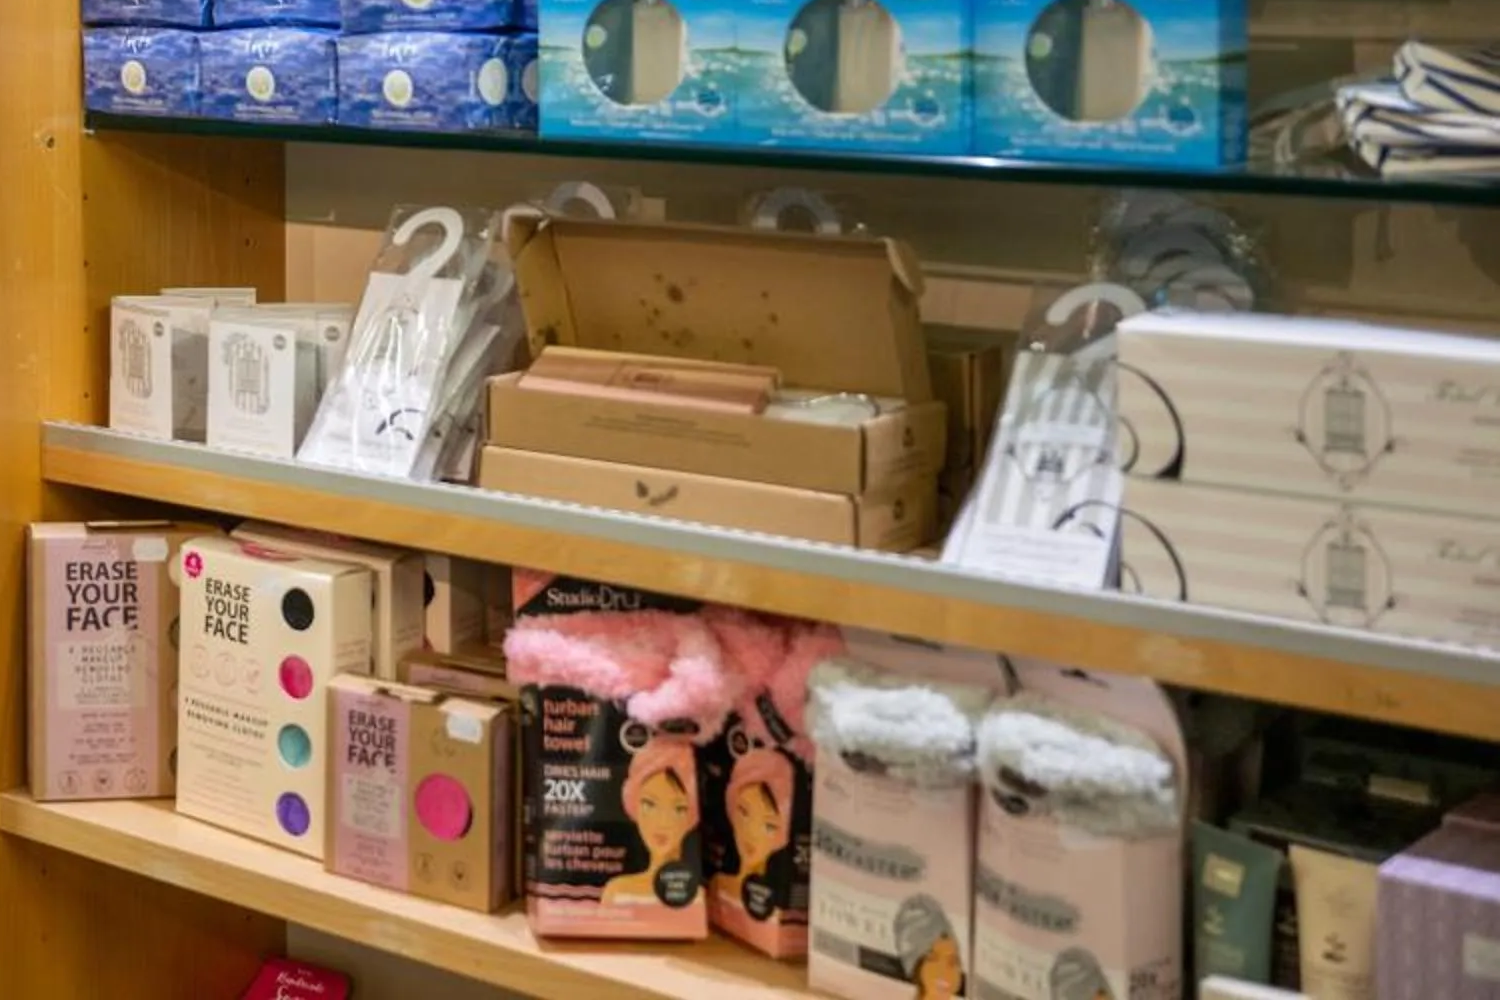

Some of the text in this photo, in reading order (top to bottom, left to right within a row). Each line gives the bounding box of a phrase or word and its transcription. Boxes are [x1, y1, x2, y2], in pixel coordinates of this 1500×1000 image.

[66, 561, 138, 581] ERASE
[66, 582, 138, 605] YOUR
[205, 577, 251, 604] ERASE
[67, 605, 139, 631] FACE
[205, 595, 249, 622] YOUR
[204, 615, 249, 645] FACE
[544, 699, 600, 716] turban
[347, 709, 397, 734] ERASE
[544, 717, 576, 733] hair
[348, 727, 396, 749] YOUR
[544, 735, 591, 751] towel
[347, 744, 397, 774] FACE
[544, 779, 586, 802] 20X
